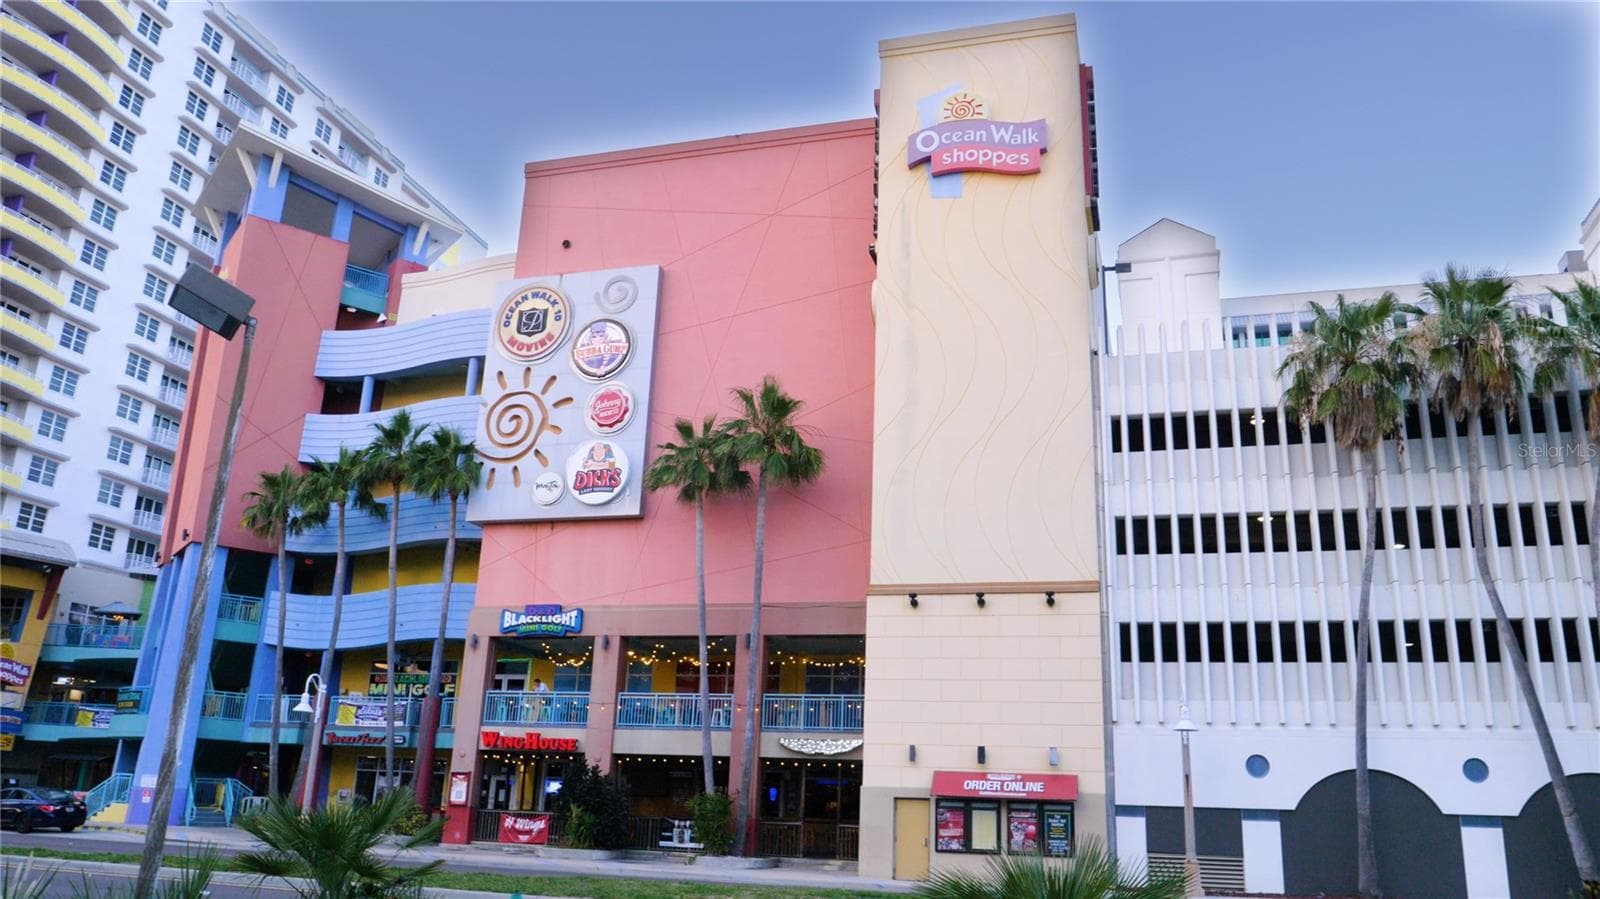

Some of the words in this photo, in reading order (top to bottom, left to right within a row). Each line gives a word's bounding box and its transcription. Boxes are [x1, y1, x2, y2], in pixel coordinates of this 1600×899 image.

[916, 129, 987, 153] Ocean
[990, 124, 1040, 145] Walk
[942, 148, 1030, 167] shoppes
[503, 294, 529, 328] OCEAN
[531, 291, 559, 308] WALK
[554, 309, 562, 322] 10
[573, 468, 622, 491] DICK'S
[503, 610, 578, 628] BLACKLIGHT
[520, 624, 538, 632] MINI
[541, 624, 562, 632] GOLF
[963, 780, 1000, 790] ORDER
[1003, 781, 1045, 792] ONLINE
